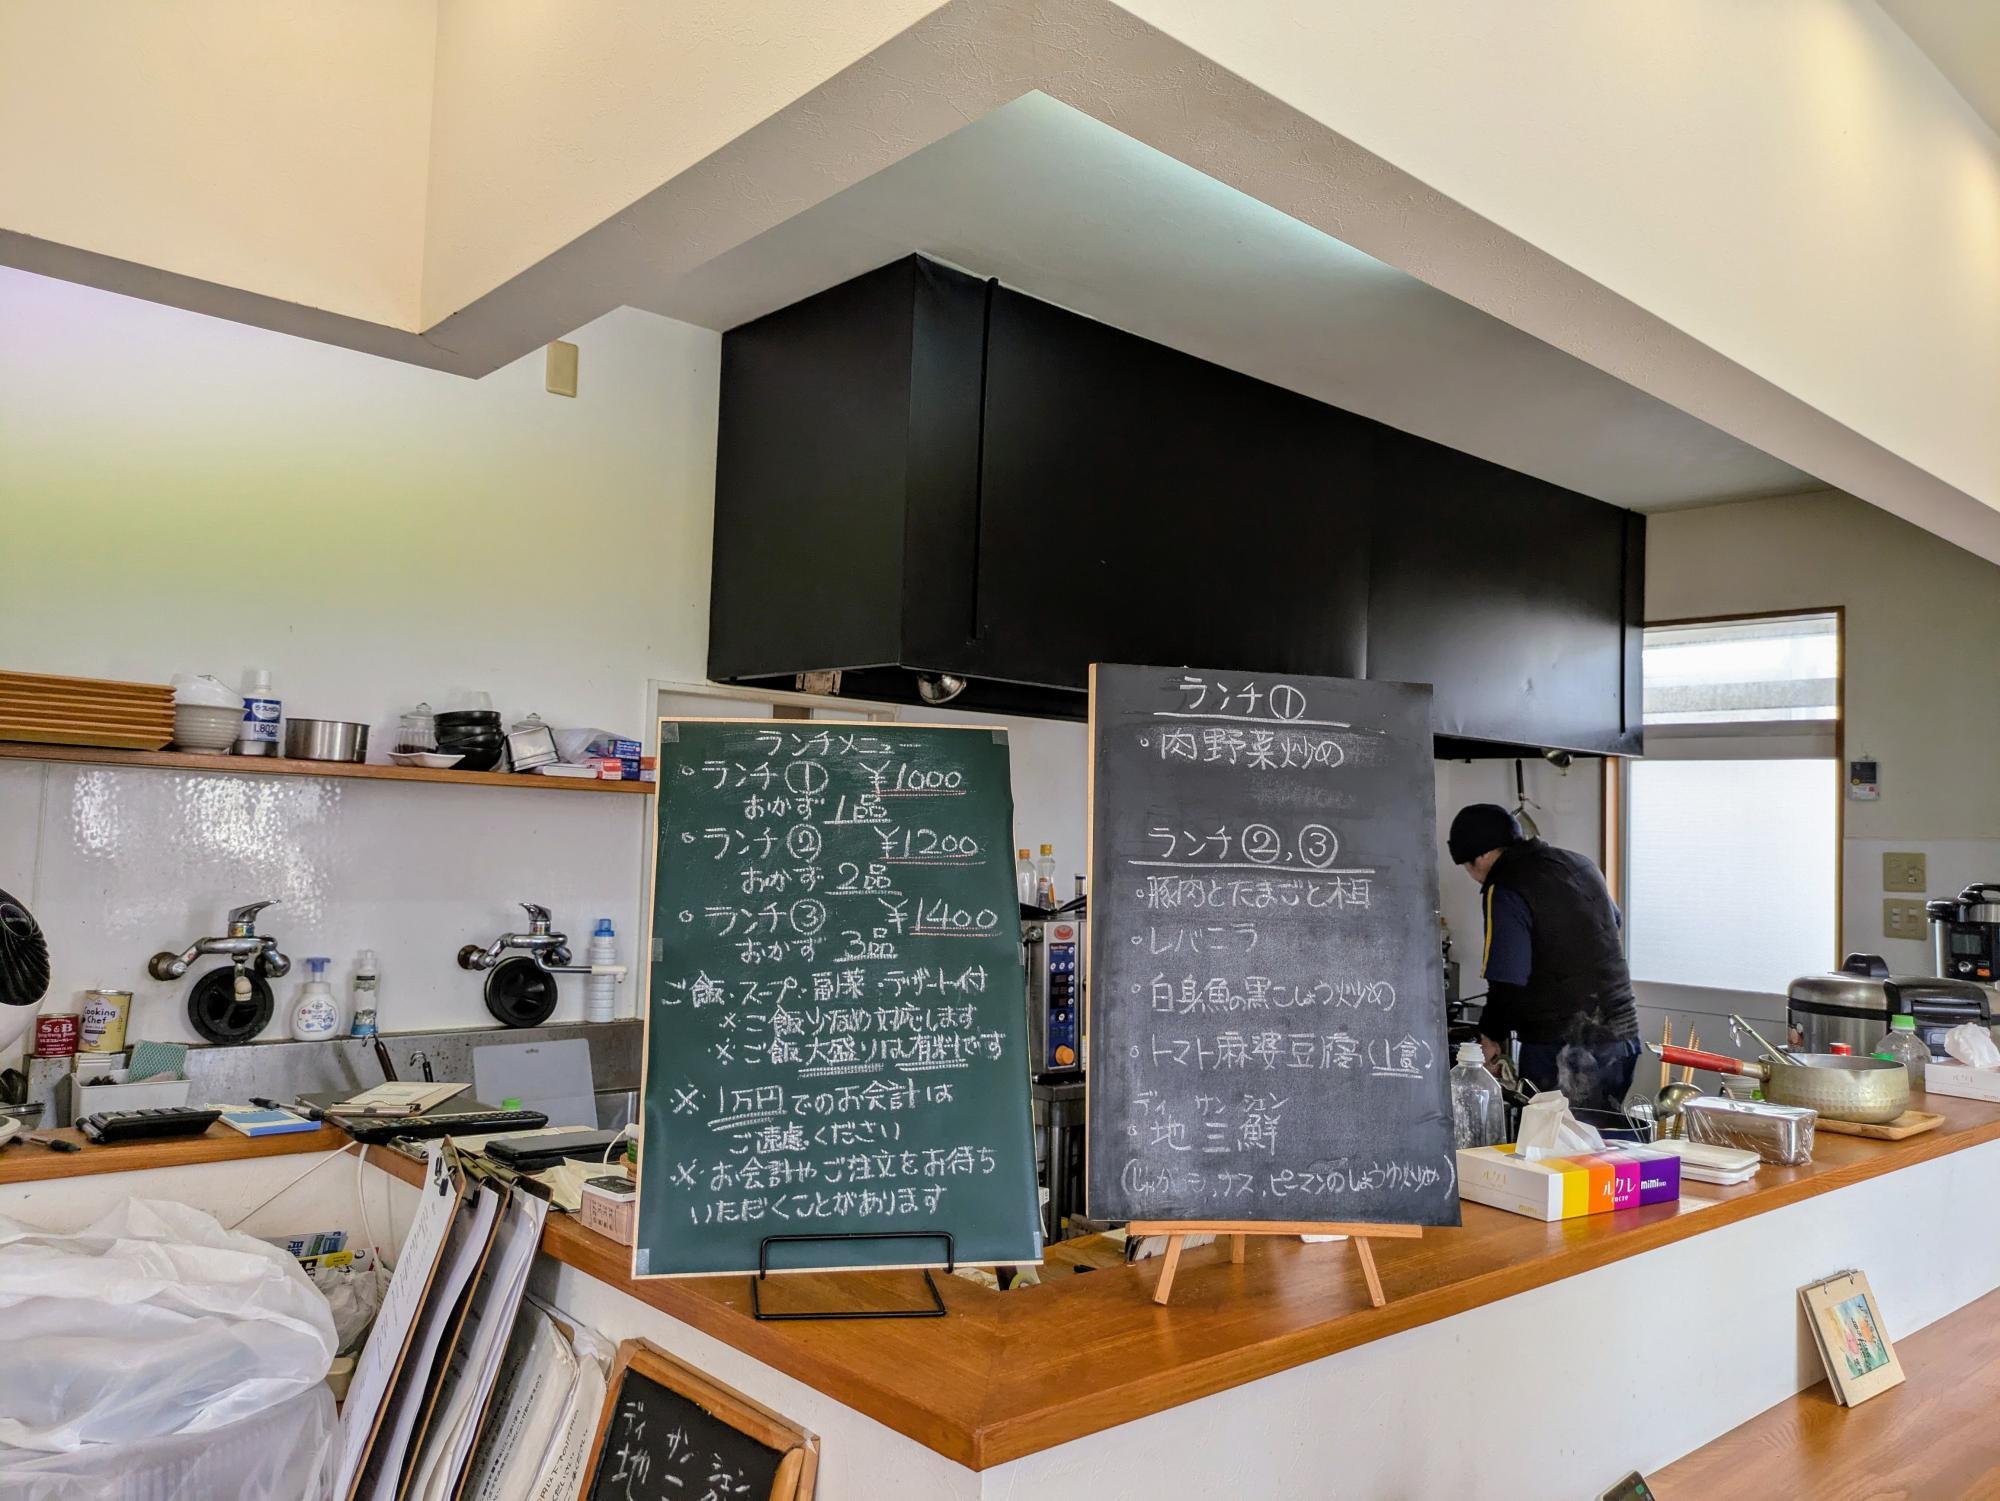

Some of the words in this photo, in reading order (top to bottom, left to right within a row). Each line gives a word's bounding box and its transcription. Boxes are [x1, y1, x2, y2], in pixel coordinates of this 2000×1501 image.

[755, 731, 922, 756] ランチメニュー
[1160, 728, 1344, 770] 肉野菜炒め
[859, 760, 962, 793] ¥1000
[743, 794, 825, 820] おかず
[833, 794, 888, 823] 1品
[873, 827, 980, 858] ¥1200
[740, 863, 825, 894] おかず
[837, 862, 892, 892] 2品
[878, 898, 998, 933] ¥1400
[735, 937, 827, 963] おかず
[841, 928, 895, 960] 3品
[1150, 922, 1258, 954] レバニラ
[84, 1006, 117, 1018] Cooking
[87, 1015, 107, 1025] Chef
[729, 1121, 901, 1155] ご遠慮ください
[1603, 1177, 1636, 1196] ルクレ
[690, 1183, 947, 1224] いただくことがあります
